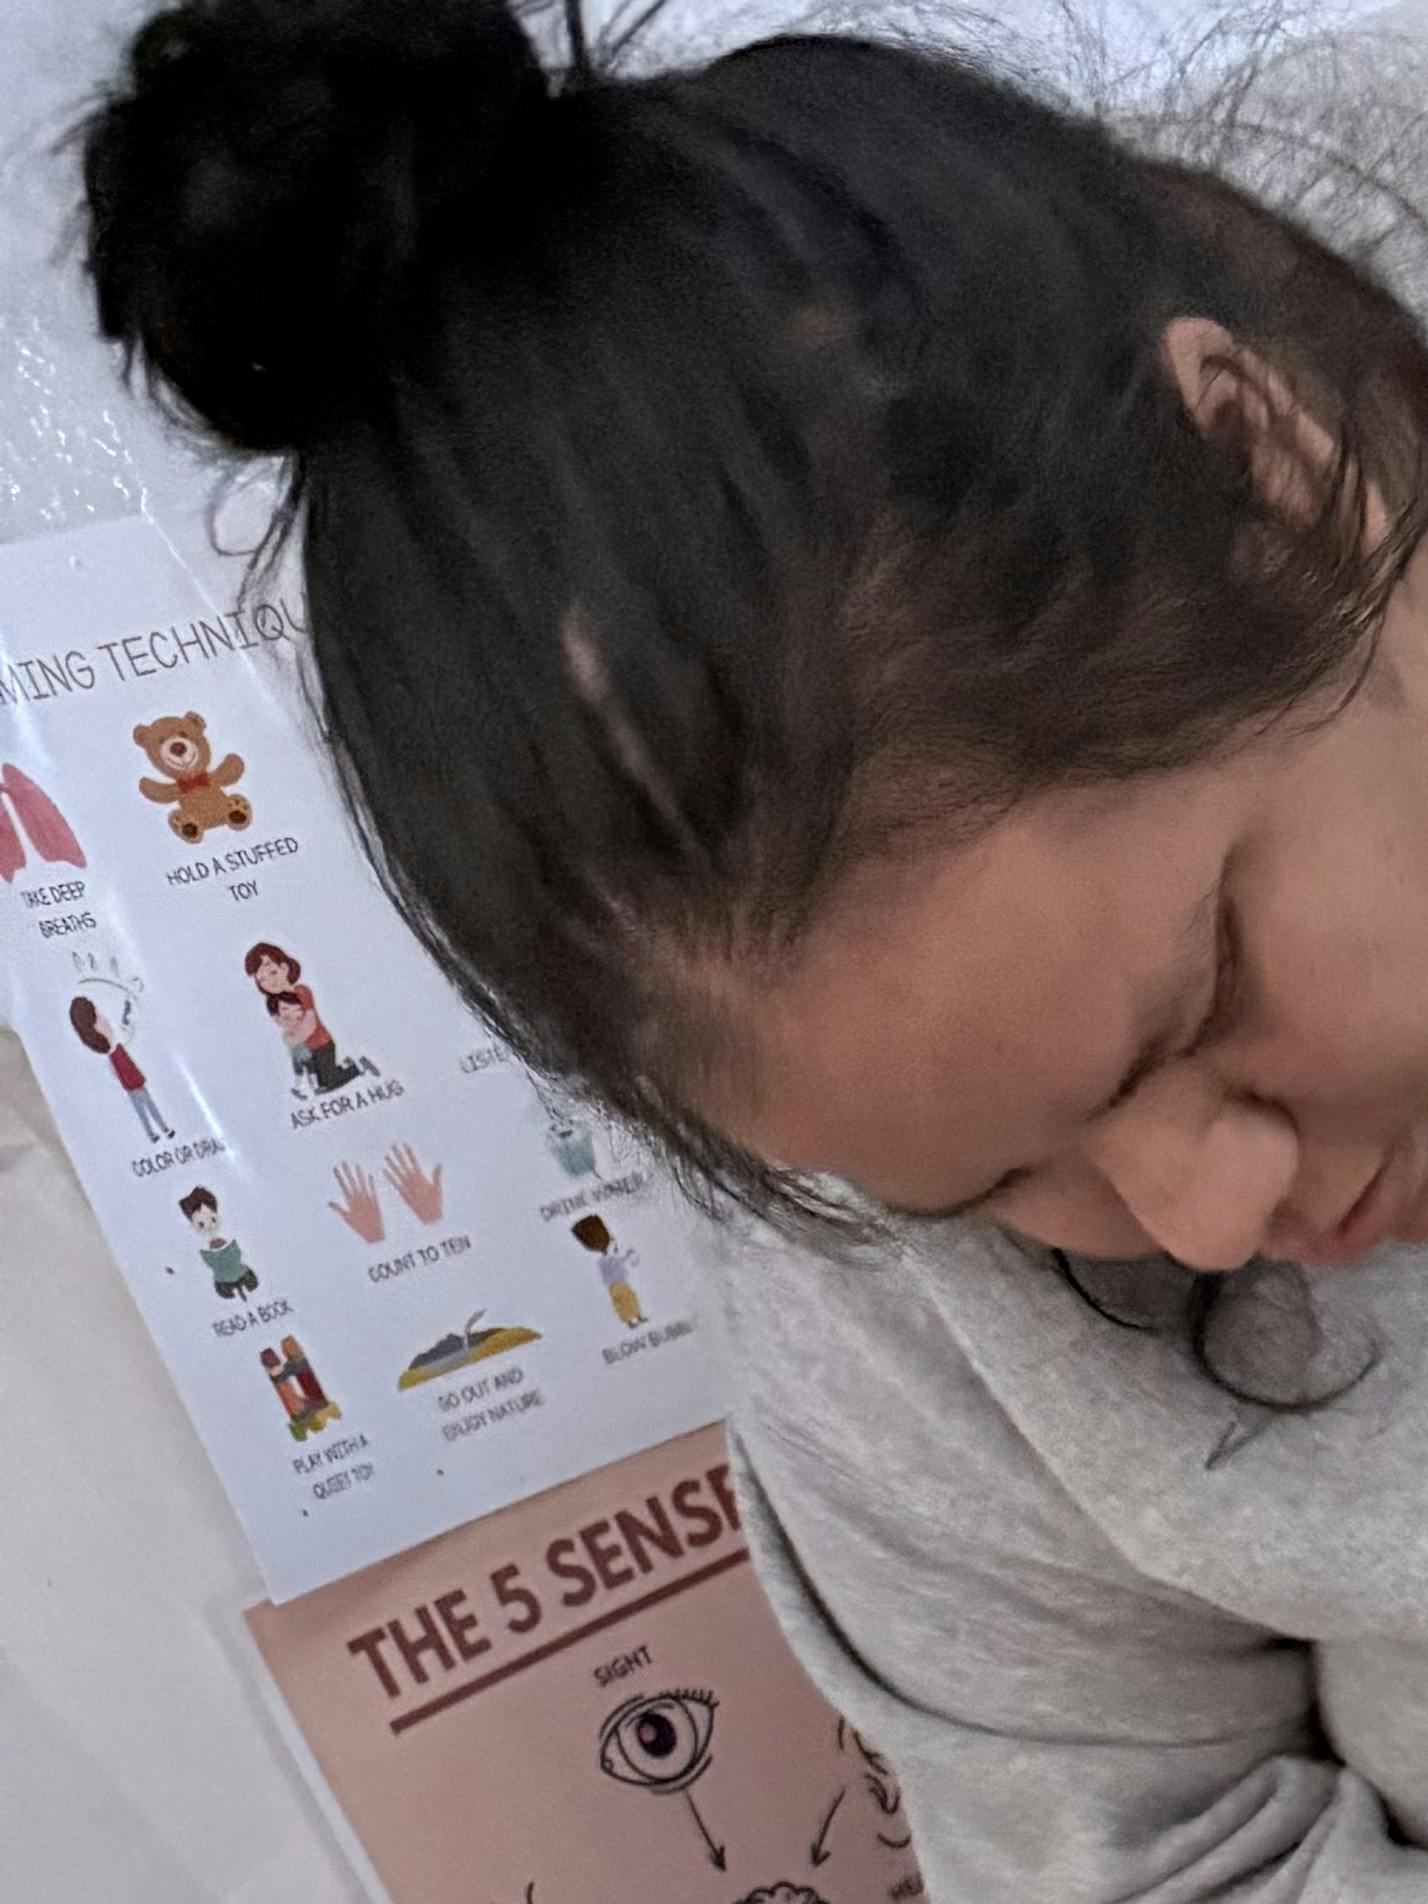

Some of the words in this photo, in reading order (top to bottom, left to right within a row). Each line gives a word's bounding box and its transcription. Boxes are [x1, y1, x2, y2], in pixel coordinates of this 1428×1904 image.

[165, 862, 210, 885] HOLD
[211, 857, 227, 876] A
[224, 837, 298, 872] STUFFED
[48, 881, 85, 904] DEEP
[228, 879, 259, 902] TOY
[290, 1106, 321, 1130] ASK
[320, 1096, 355, 1120] FOR
[355, 1090, 369, 1109] A
[367, 1078, 404, 1104] HUG
[131, 1151, 175, 1178] COLOR
[368, 1249, 417, 1283] COUNT
[416, 1245, 440, 1266] TO
[212, 1314, 247, 1338] READ
[247, 1310, 260, 1327] A
[257, 1300, 295, 1324] BOOK
[460, 1377, 490, 1402] OUT
[346, 1589, 492, 1700] THE
[489, 1562, 542, 1635] 5
[593, 1644, 653, 1688] SIGHT
